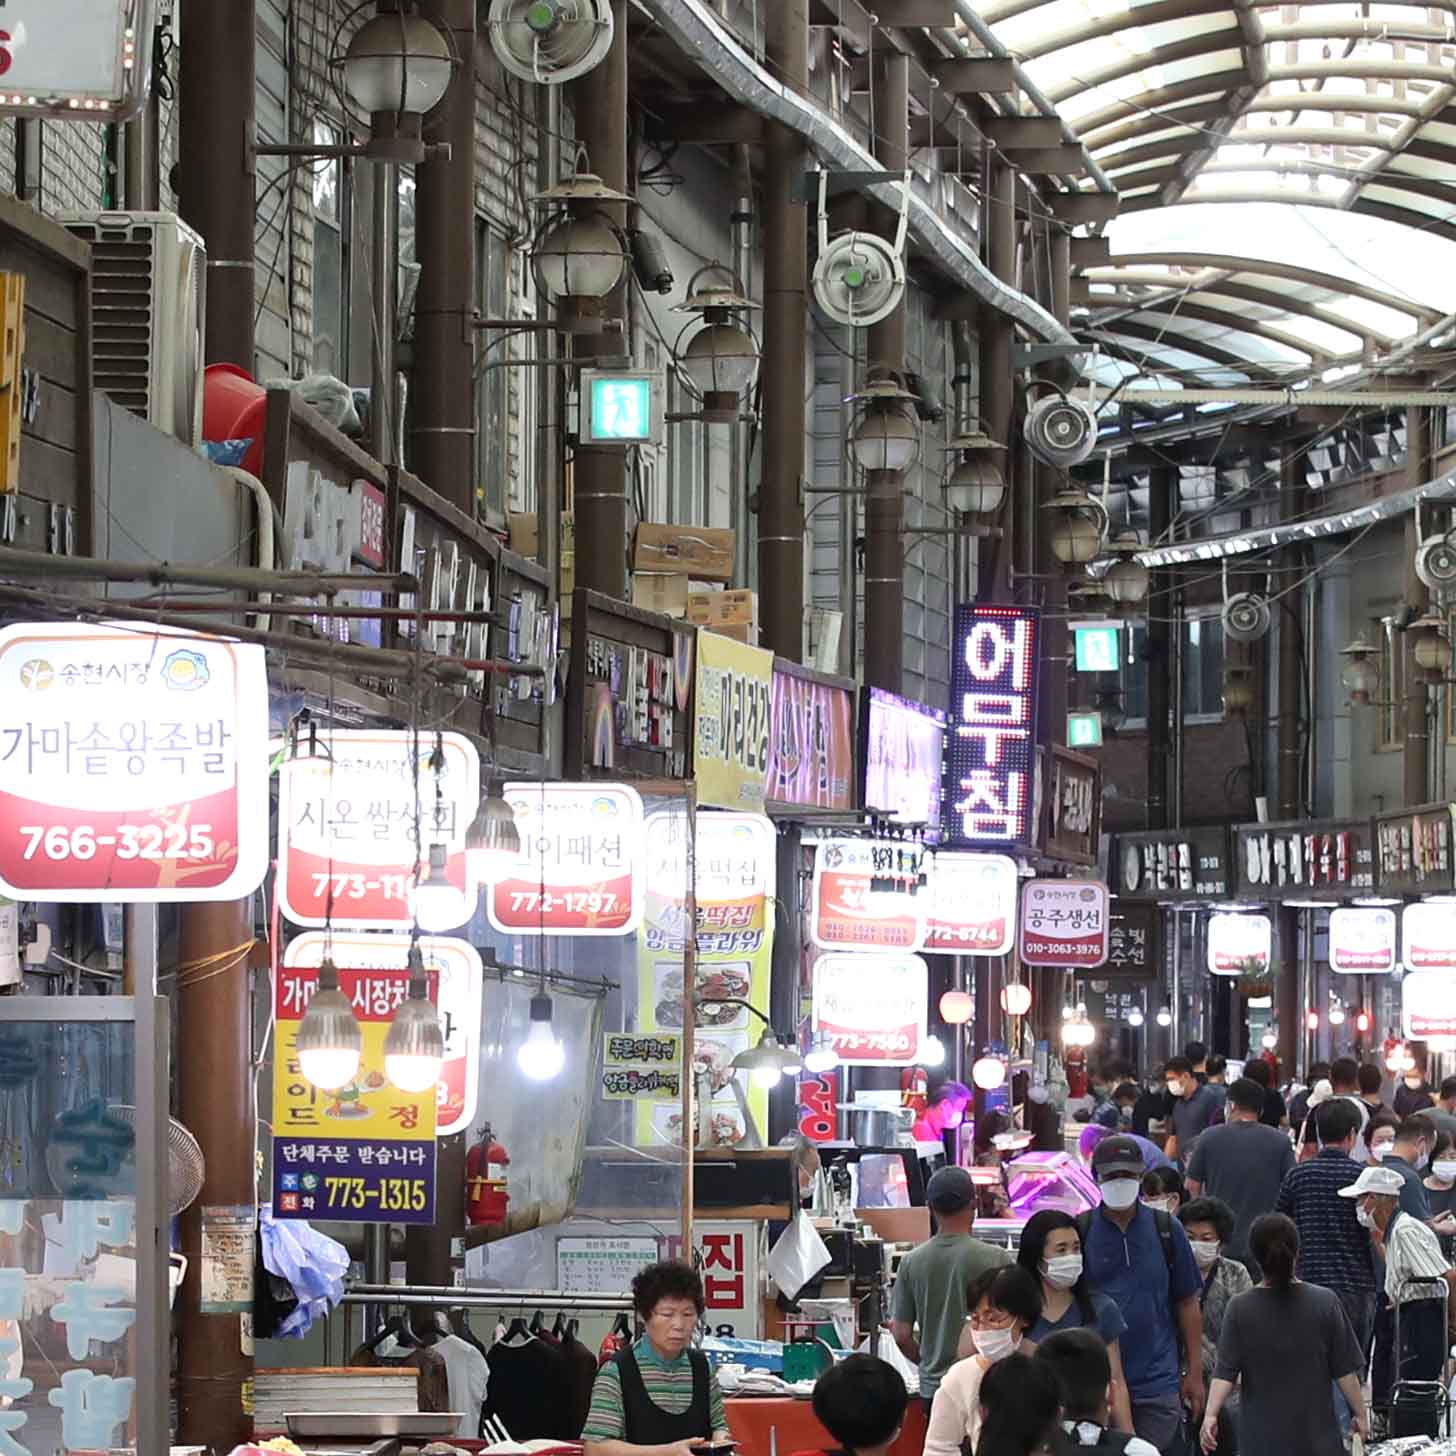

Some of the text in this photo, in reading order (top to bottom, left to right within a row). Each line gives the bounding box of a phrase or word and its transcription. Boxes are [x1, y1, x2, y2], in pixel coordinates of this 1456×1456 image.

[0, 718, 232, 777] 가마솥왕족발
[19, 824, 213, 860] 766-3225
[311, 871, 412, 899] 773-11
[510, 891, 616, 913] 772-1797
[1028, 906, 1101, 931] 공주생선
[1026, 943, 1101, 955] 010-3063-3976
[281, 1143, 427, 1167] 단체주문 받습니다
[324, 1176, 426, 1212] 773-1315
